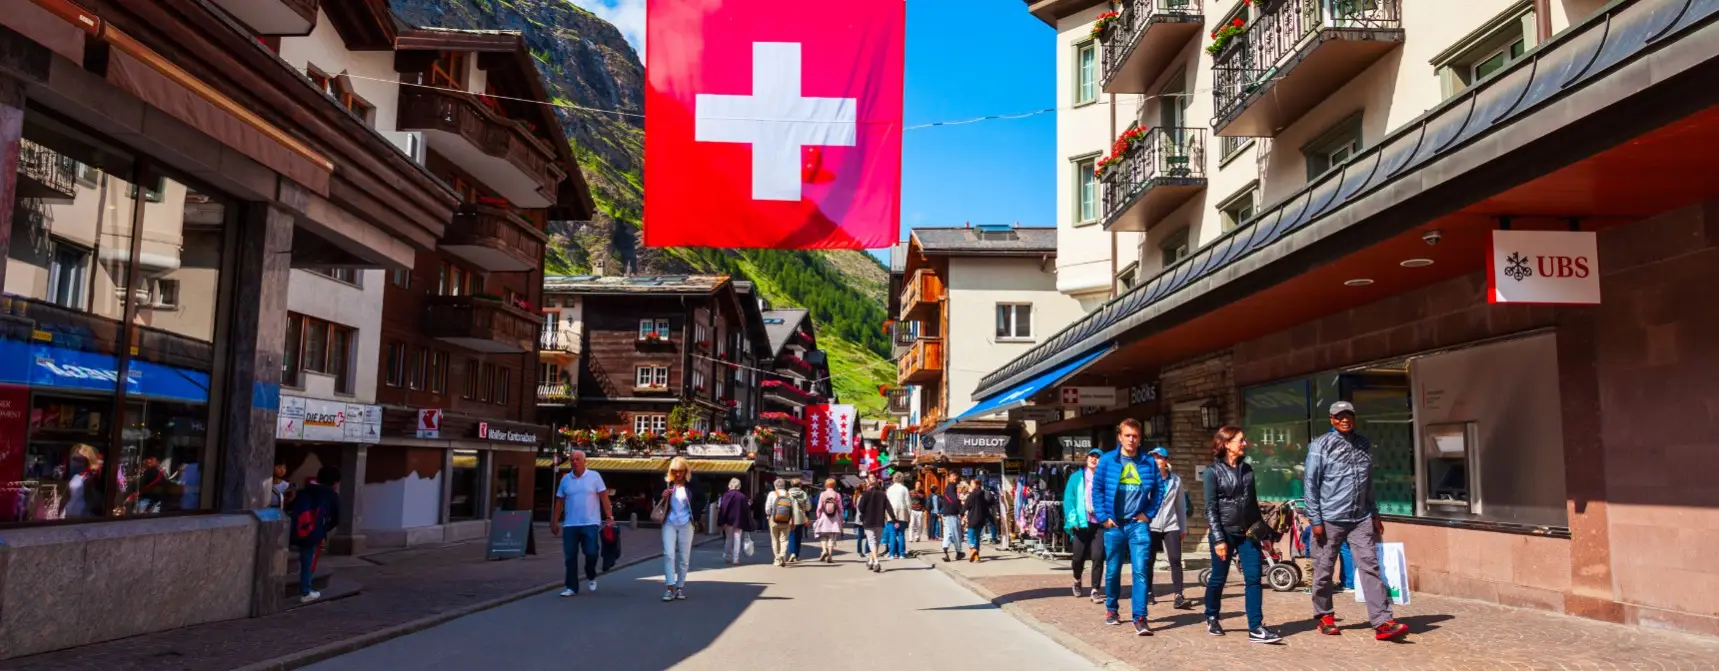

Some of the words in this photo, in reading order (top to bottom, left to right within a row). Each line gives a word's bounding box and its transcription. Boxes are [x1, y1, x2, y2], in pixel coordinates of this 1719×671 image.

[1536, 256, 1590, 279] UBS
[306, 413, 318, 422] DIE
[319, 414, 337, 424] POST
[963, 438, 1006, 447] HUBLOT
